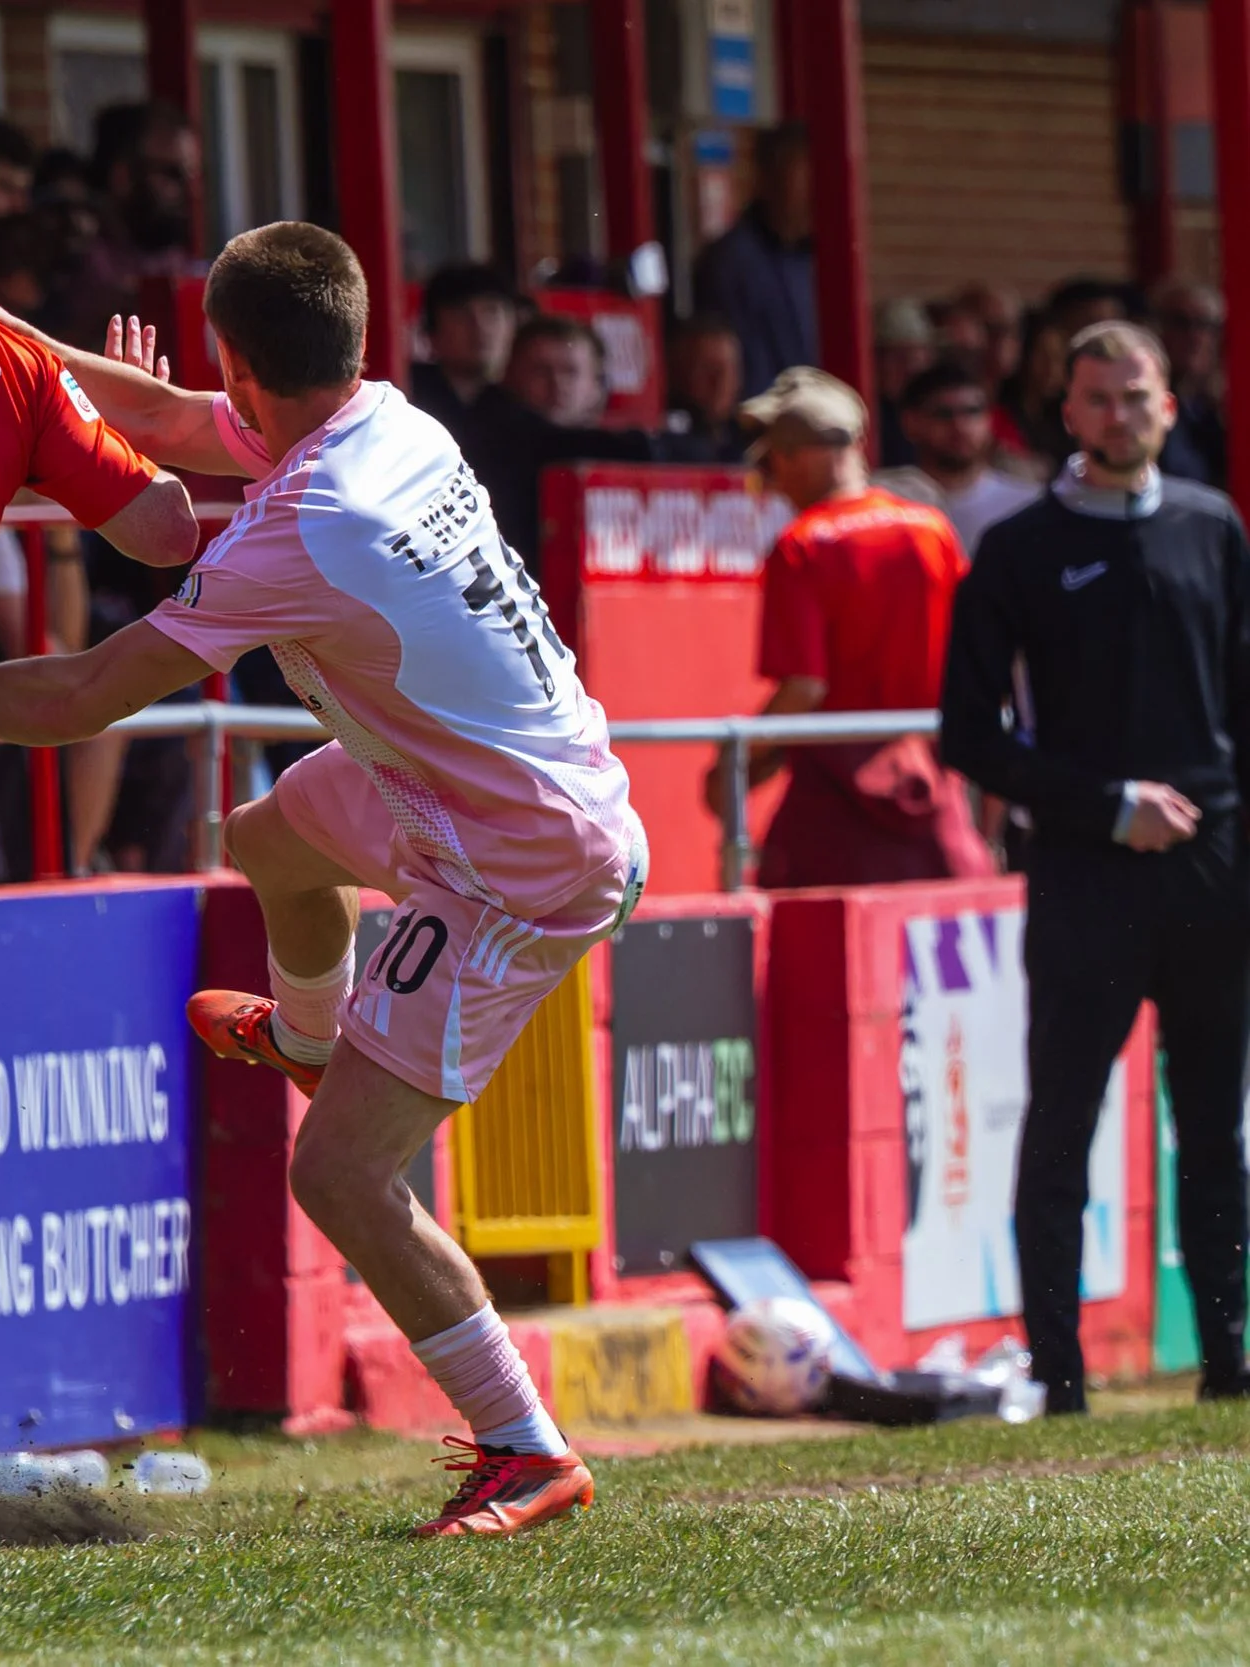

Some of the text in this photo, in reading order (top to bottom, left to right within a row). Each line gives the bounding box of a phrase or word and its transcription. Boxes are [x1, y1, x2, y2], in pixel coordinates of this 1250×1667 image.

[370, 908, 448, 995] 10
[12, 1042, 169, 1152] WINNING
[41, 1197, 190, 1312] BUTCHER
